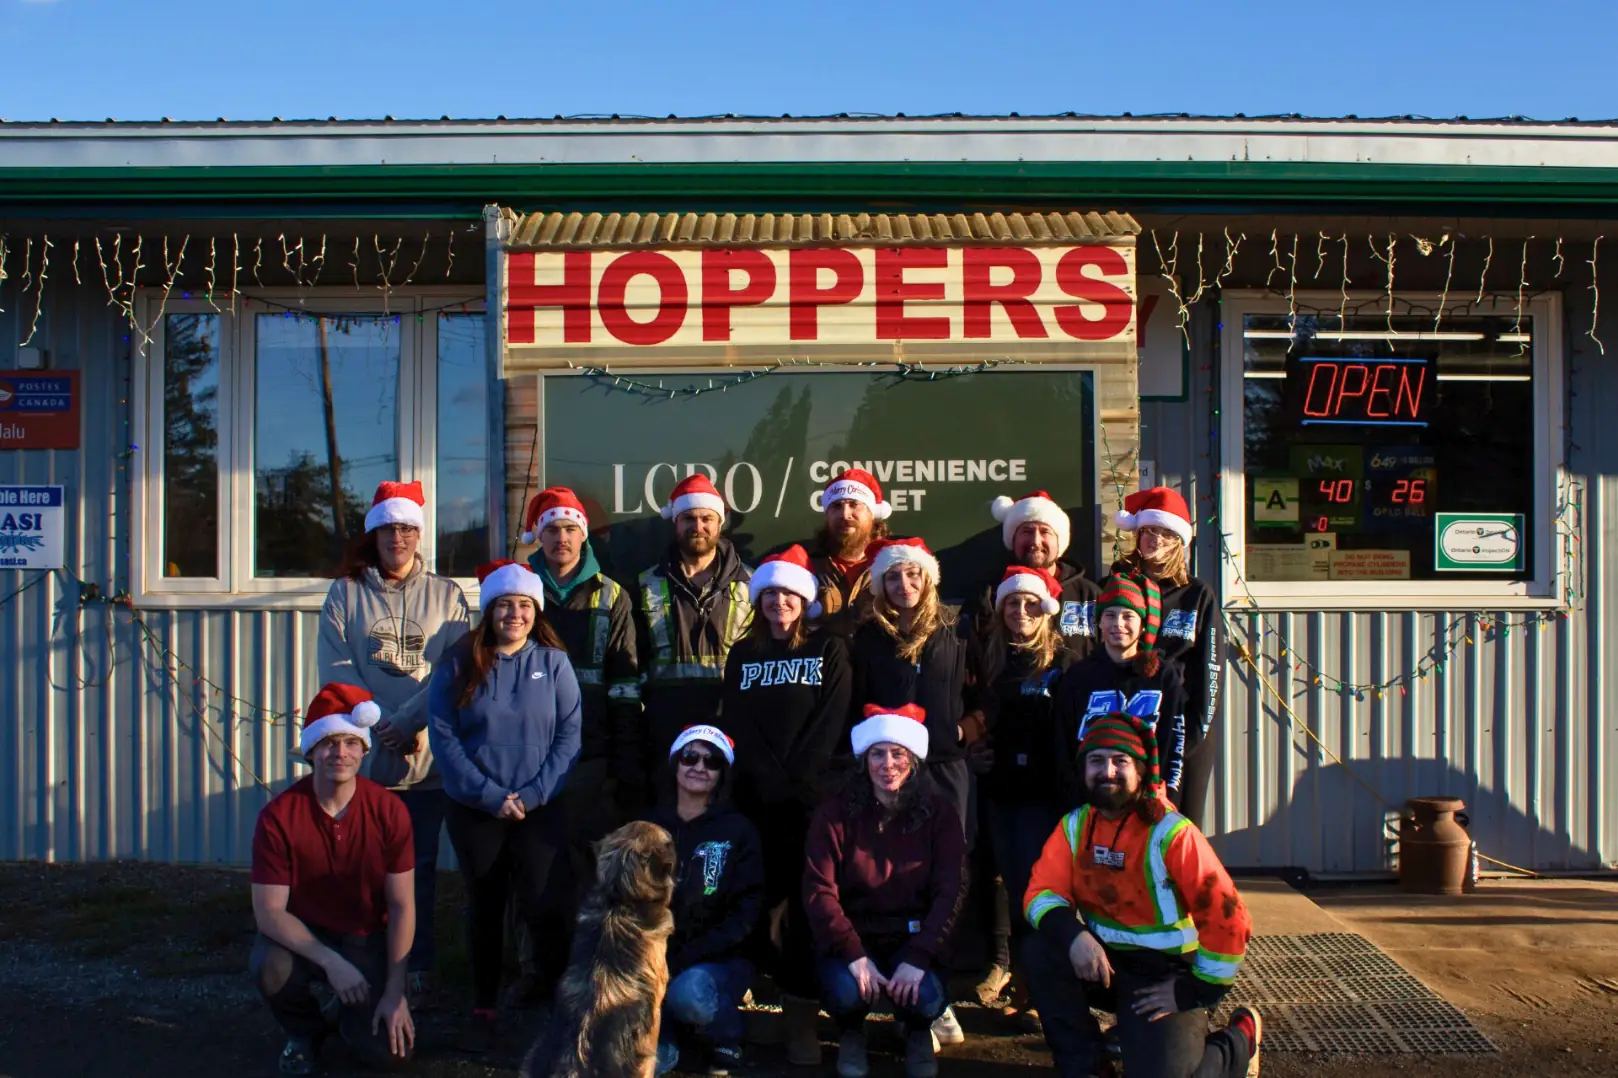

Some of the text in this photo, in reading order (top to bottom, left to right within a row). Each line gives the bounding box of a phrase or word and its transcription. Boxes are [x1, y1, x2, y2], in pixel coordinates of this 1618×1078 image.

[508, 246, 1133, 346] HOPPERS
[19, 382, 60, 391] POSTES
[1304, 363, 1426, 418] OPEN
[18, 398, 65, 407] CANADA
[20, 489, 51, 504] Here
[1265, 489, 1287, 510] A
[1319, 479, 1353, 503] 40
[1391, 479, 1425, 503] 26
[740, 657, 824, 690] PINK
